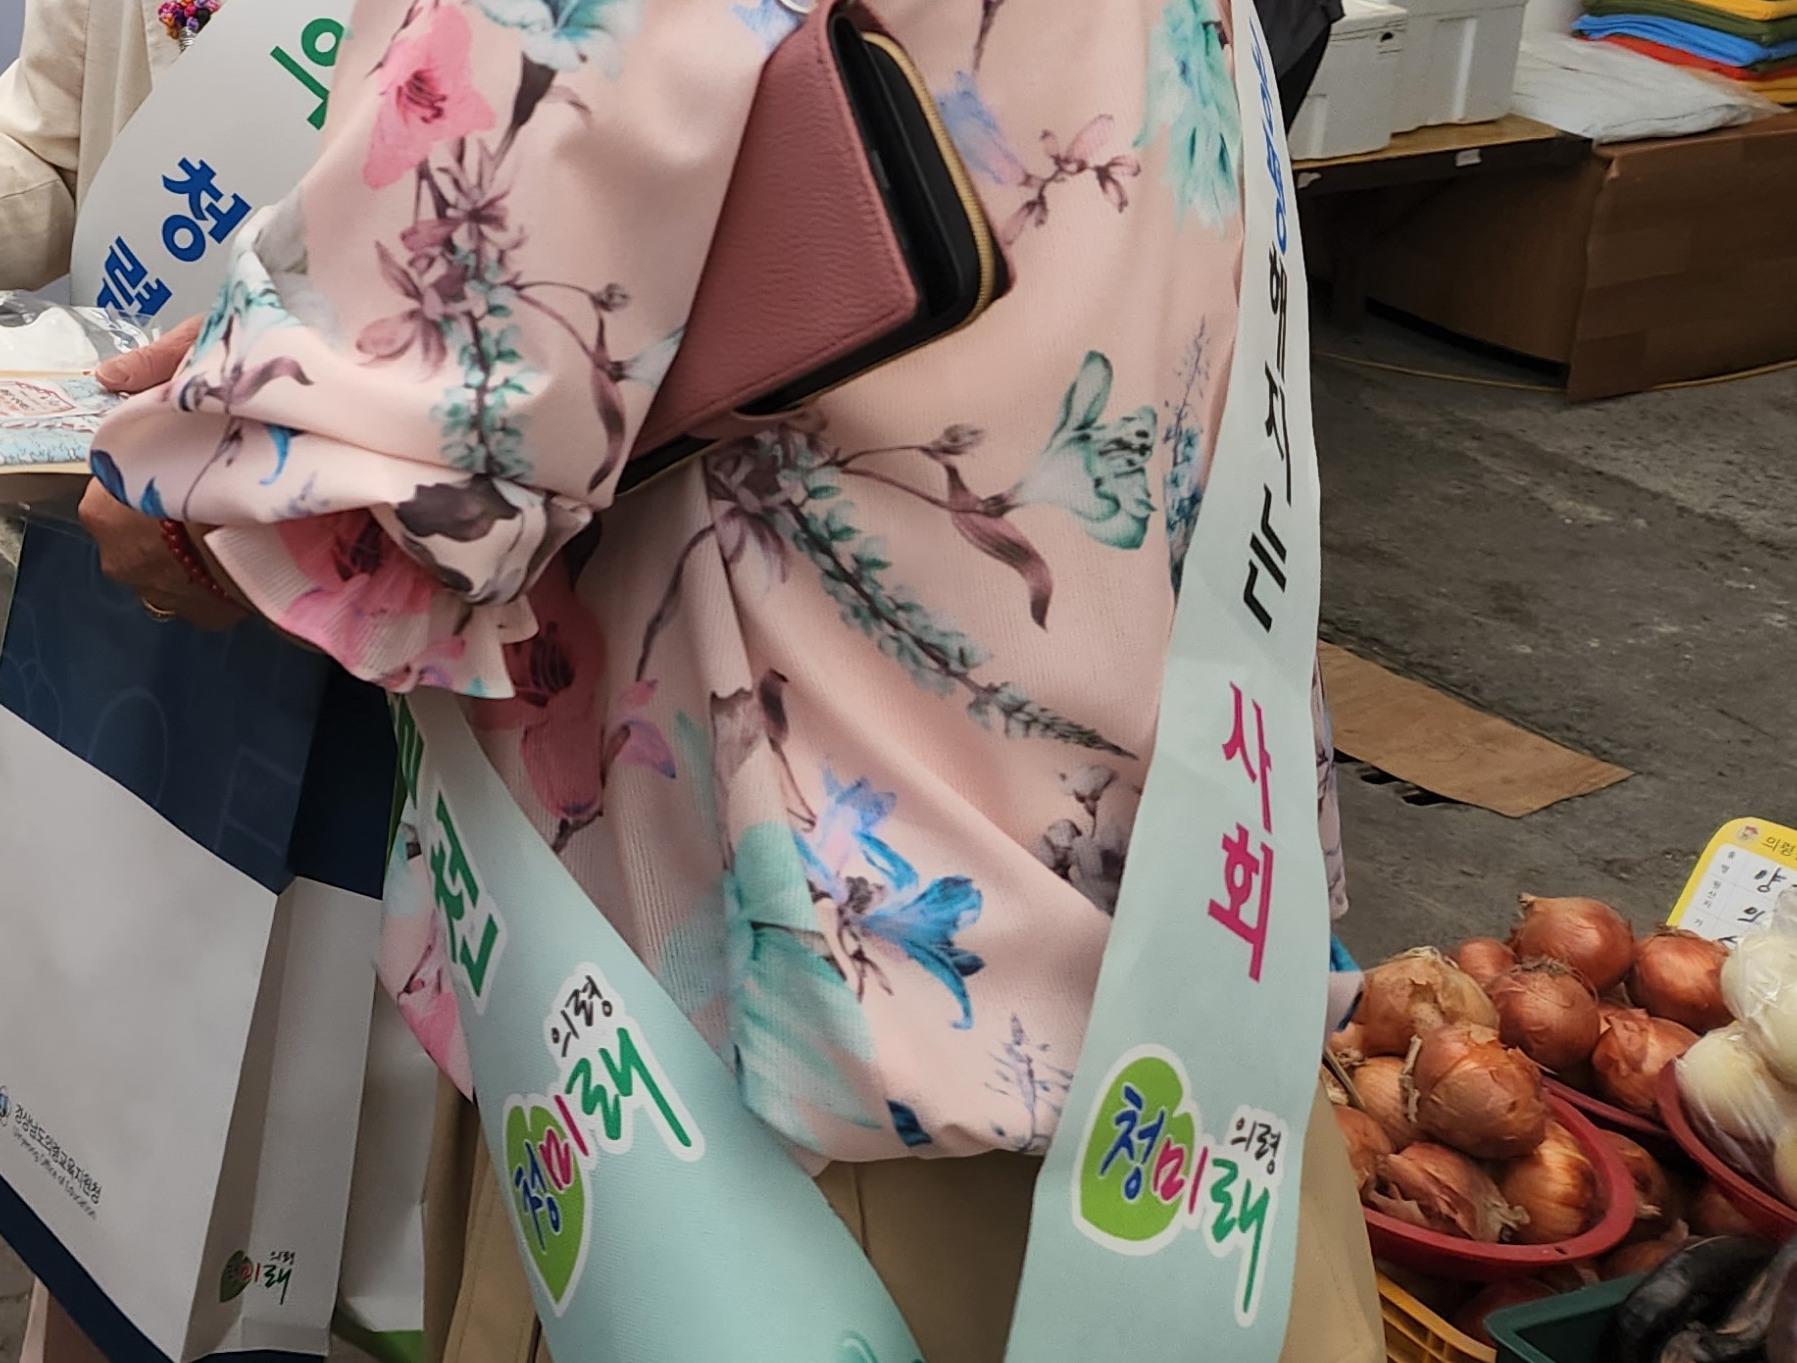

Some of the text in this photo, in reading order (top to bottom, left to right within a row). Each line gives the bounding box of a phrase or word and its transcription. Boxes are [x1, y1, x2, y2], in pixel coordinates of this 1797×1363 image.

[1206, 681, 1275, 984] 사회
[1762, 836, 1797, 861] 의령
[1753, 866, 1797, 894] 양
[546, 974, 615, 1061] 의령
[1232, 1117, 1283, 1175] 의령
[1101, 1082, 1269, 1315] 청미래
